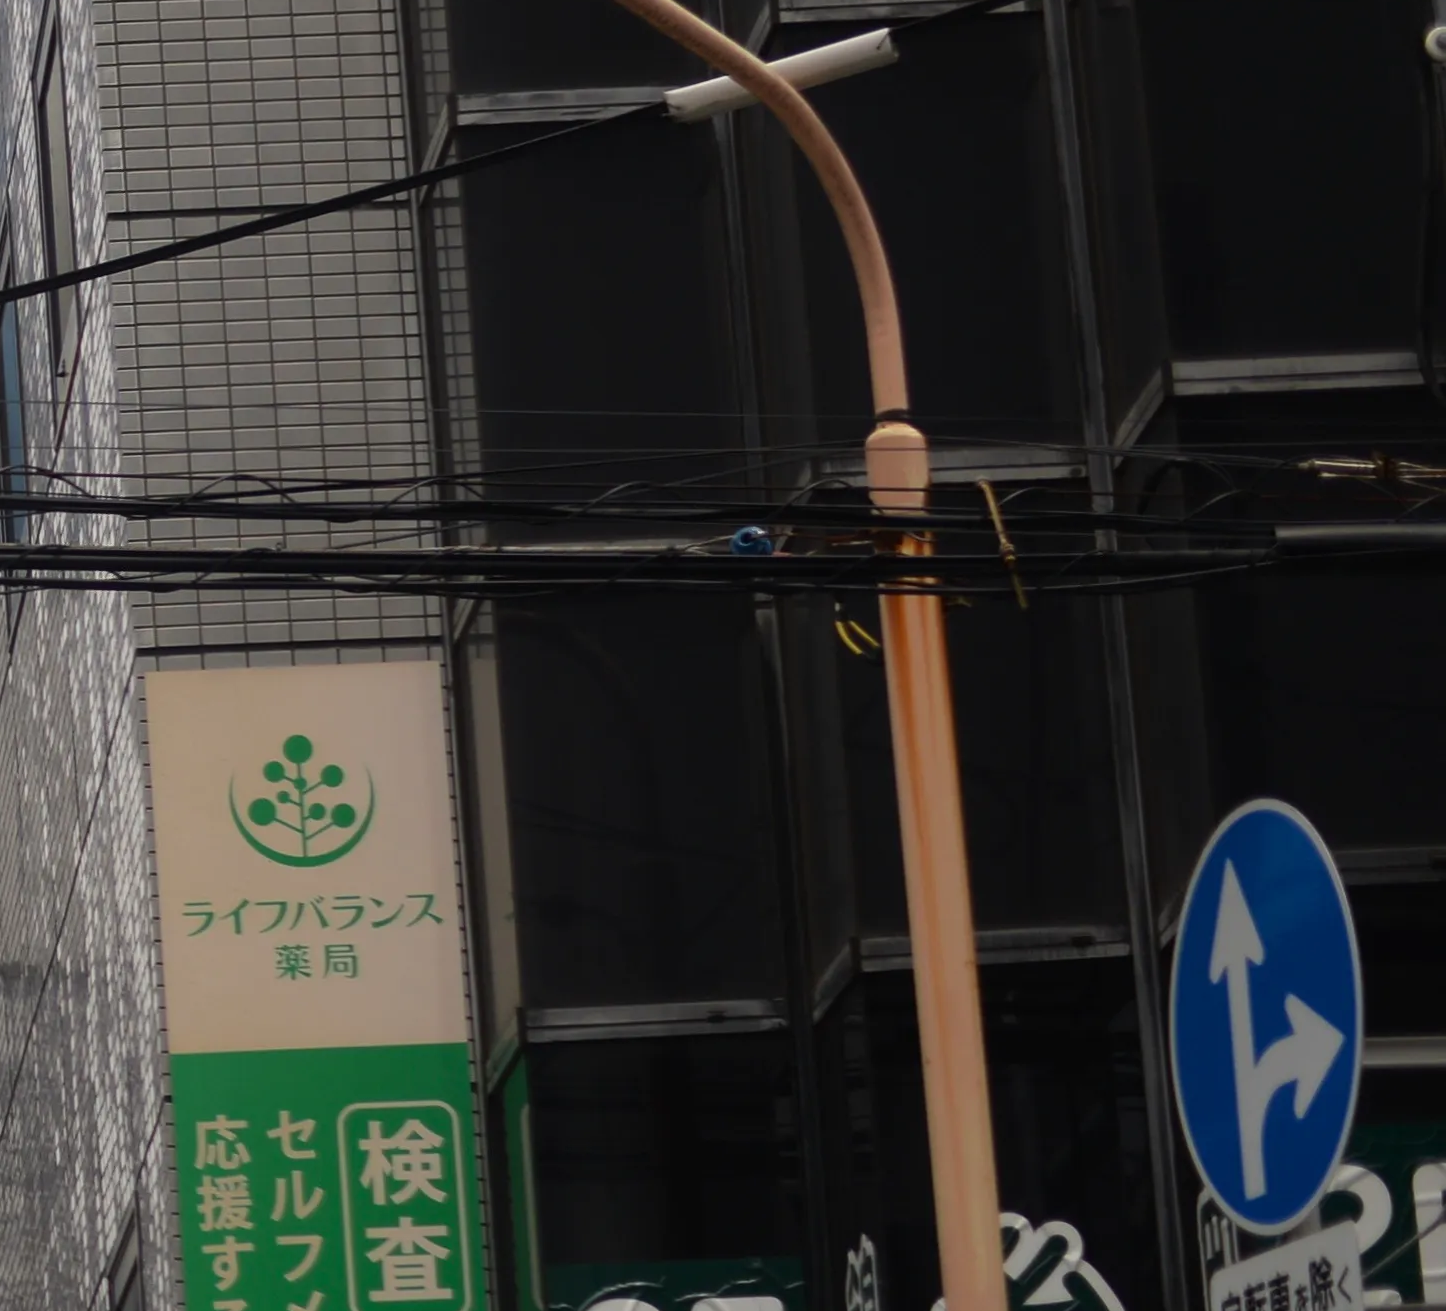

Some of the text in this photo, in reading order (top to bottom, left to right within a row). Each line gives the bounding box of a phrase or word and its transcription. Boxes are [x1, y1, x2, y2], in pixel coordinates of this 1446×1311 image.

[181, 893, 444, 937] ライフバランス
[274, 944, 360, 981] 薬局
